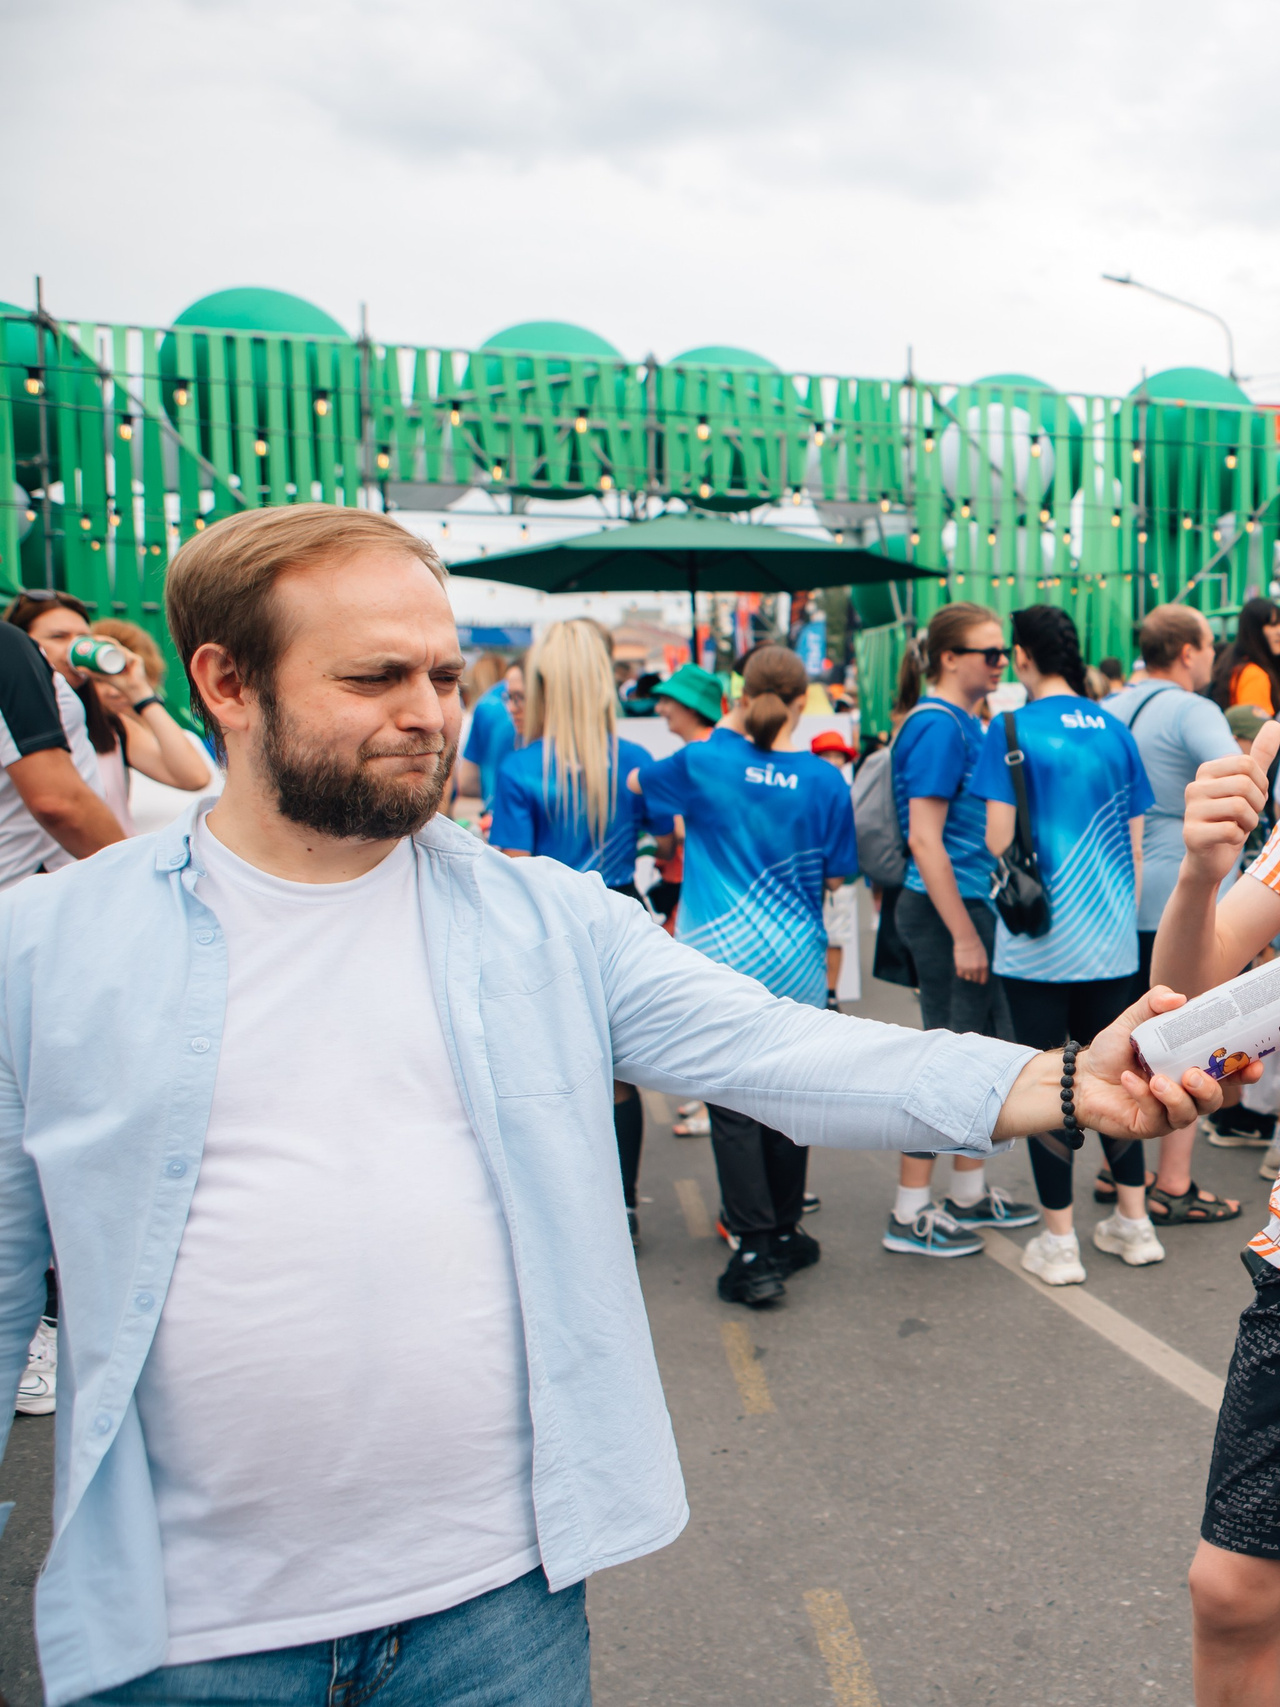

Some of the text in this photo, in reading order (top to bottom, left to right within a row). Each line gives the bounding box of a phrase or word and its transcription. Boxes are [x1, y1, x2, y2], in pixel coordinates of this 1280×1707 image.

[1254, 1329, 1266, 1339] FILA
[1268, 1338, 1280, 1347] FILA
[1262, 1350, 1272, 1358] FILA
[1269, 1346, 1280, 1355] FILA
[1261, 1366, 1276, 1375] FILA
[1231, 1540, 1248, 1548] FILA
[1243, 1536, 1260, 1544] FILA
